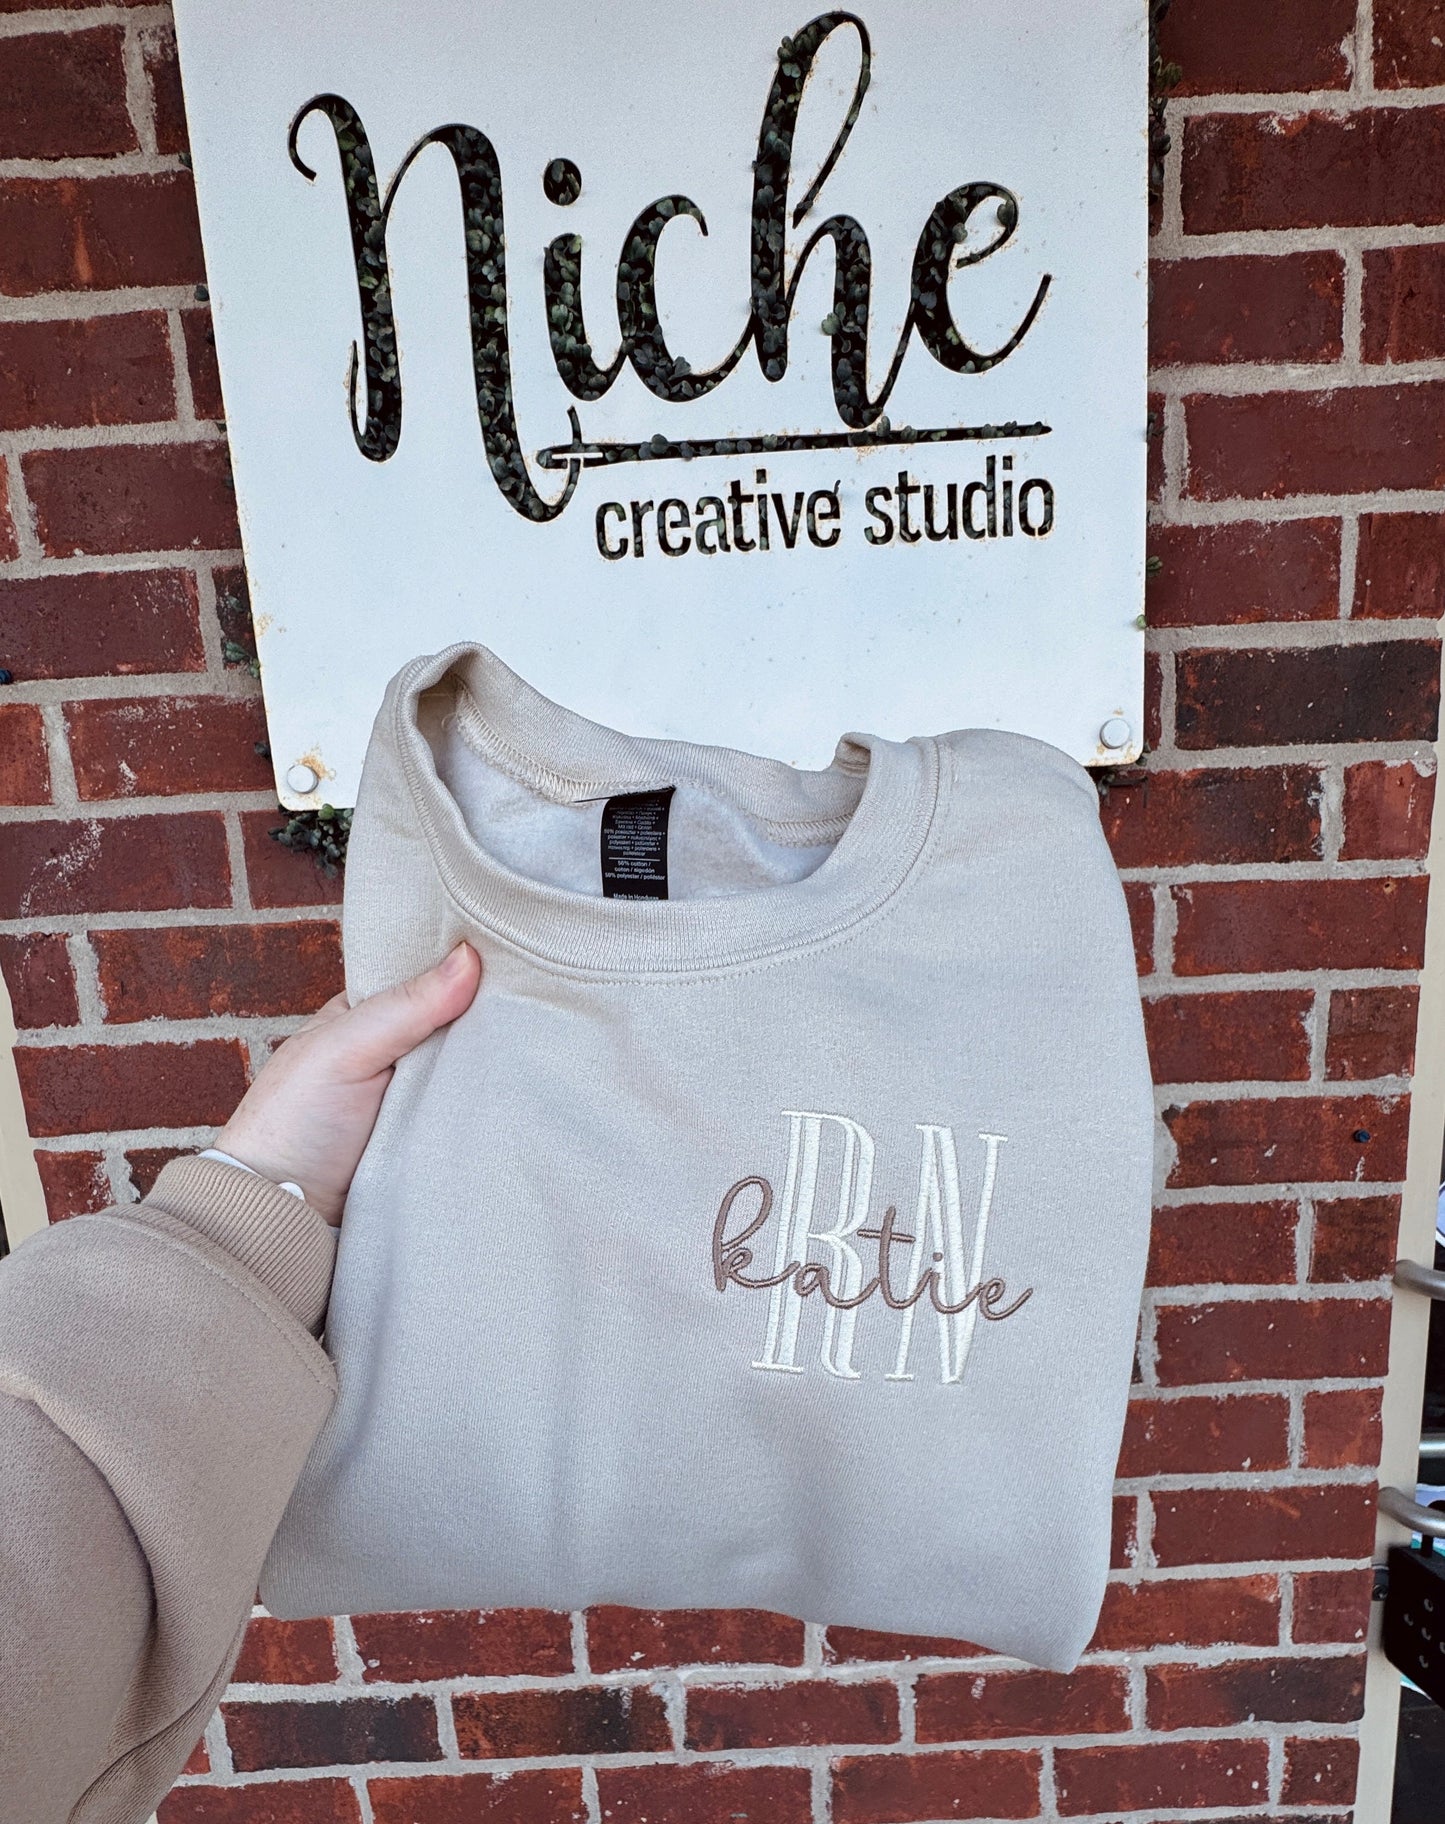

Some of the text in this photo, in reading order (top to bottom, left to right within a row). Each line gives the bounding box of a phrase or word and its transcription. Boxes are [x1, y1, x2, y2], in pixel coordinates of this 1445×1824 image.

[595, 456, 1055, 560] creative studio
[712, 1175, 1034, 1321] katie
[751, 1109, 1009, 1385] RN
